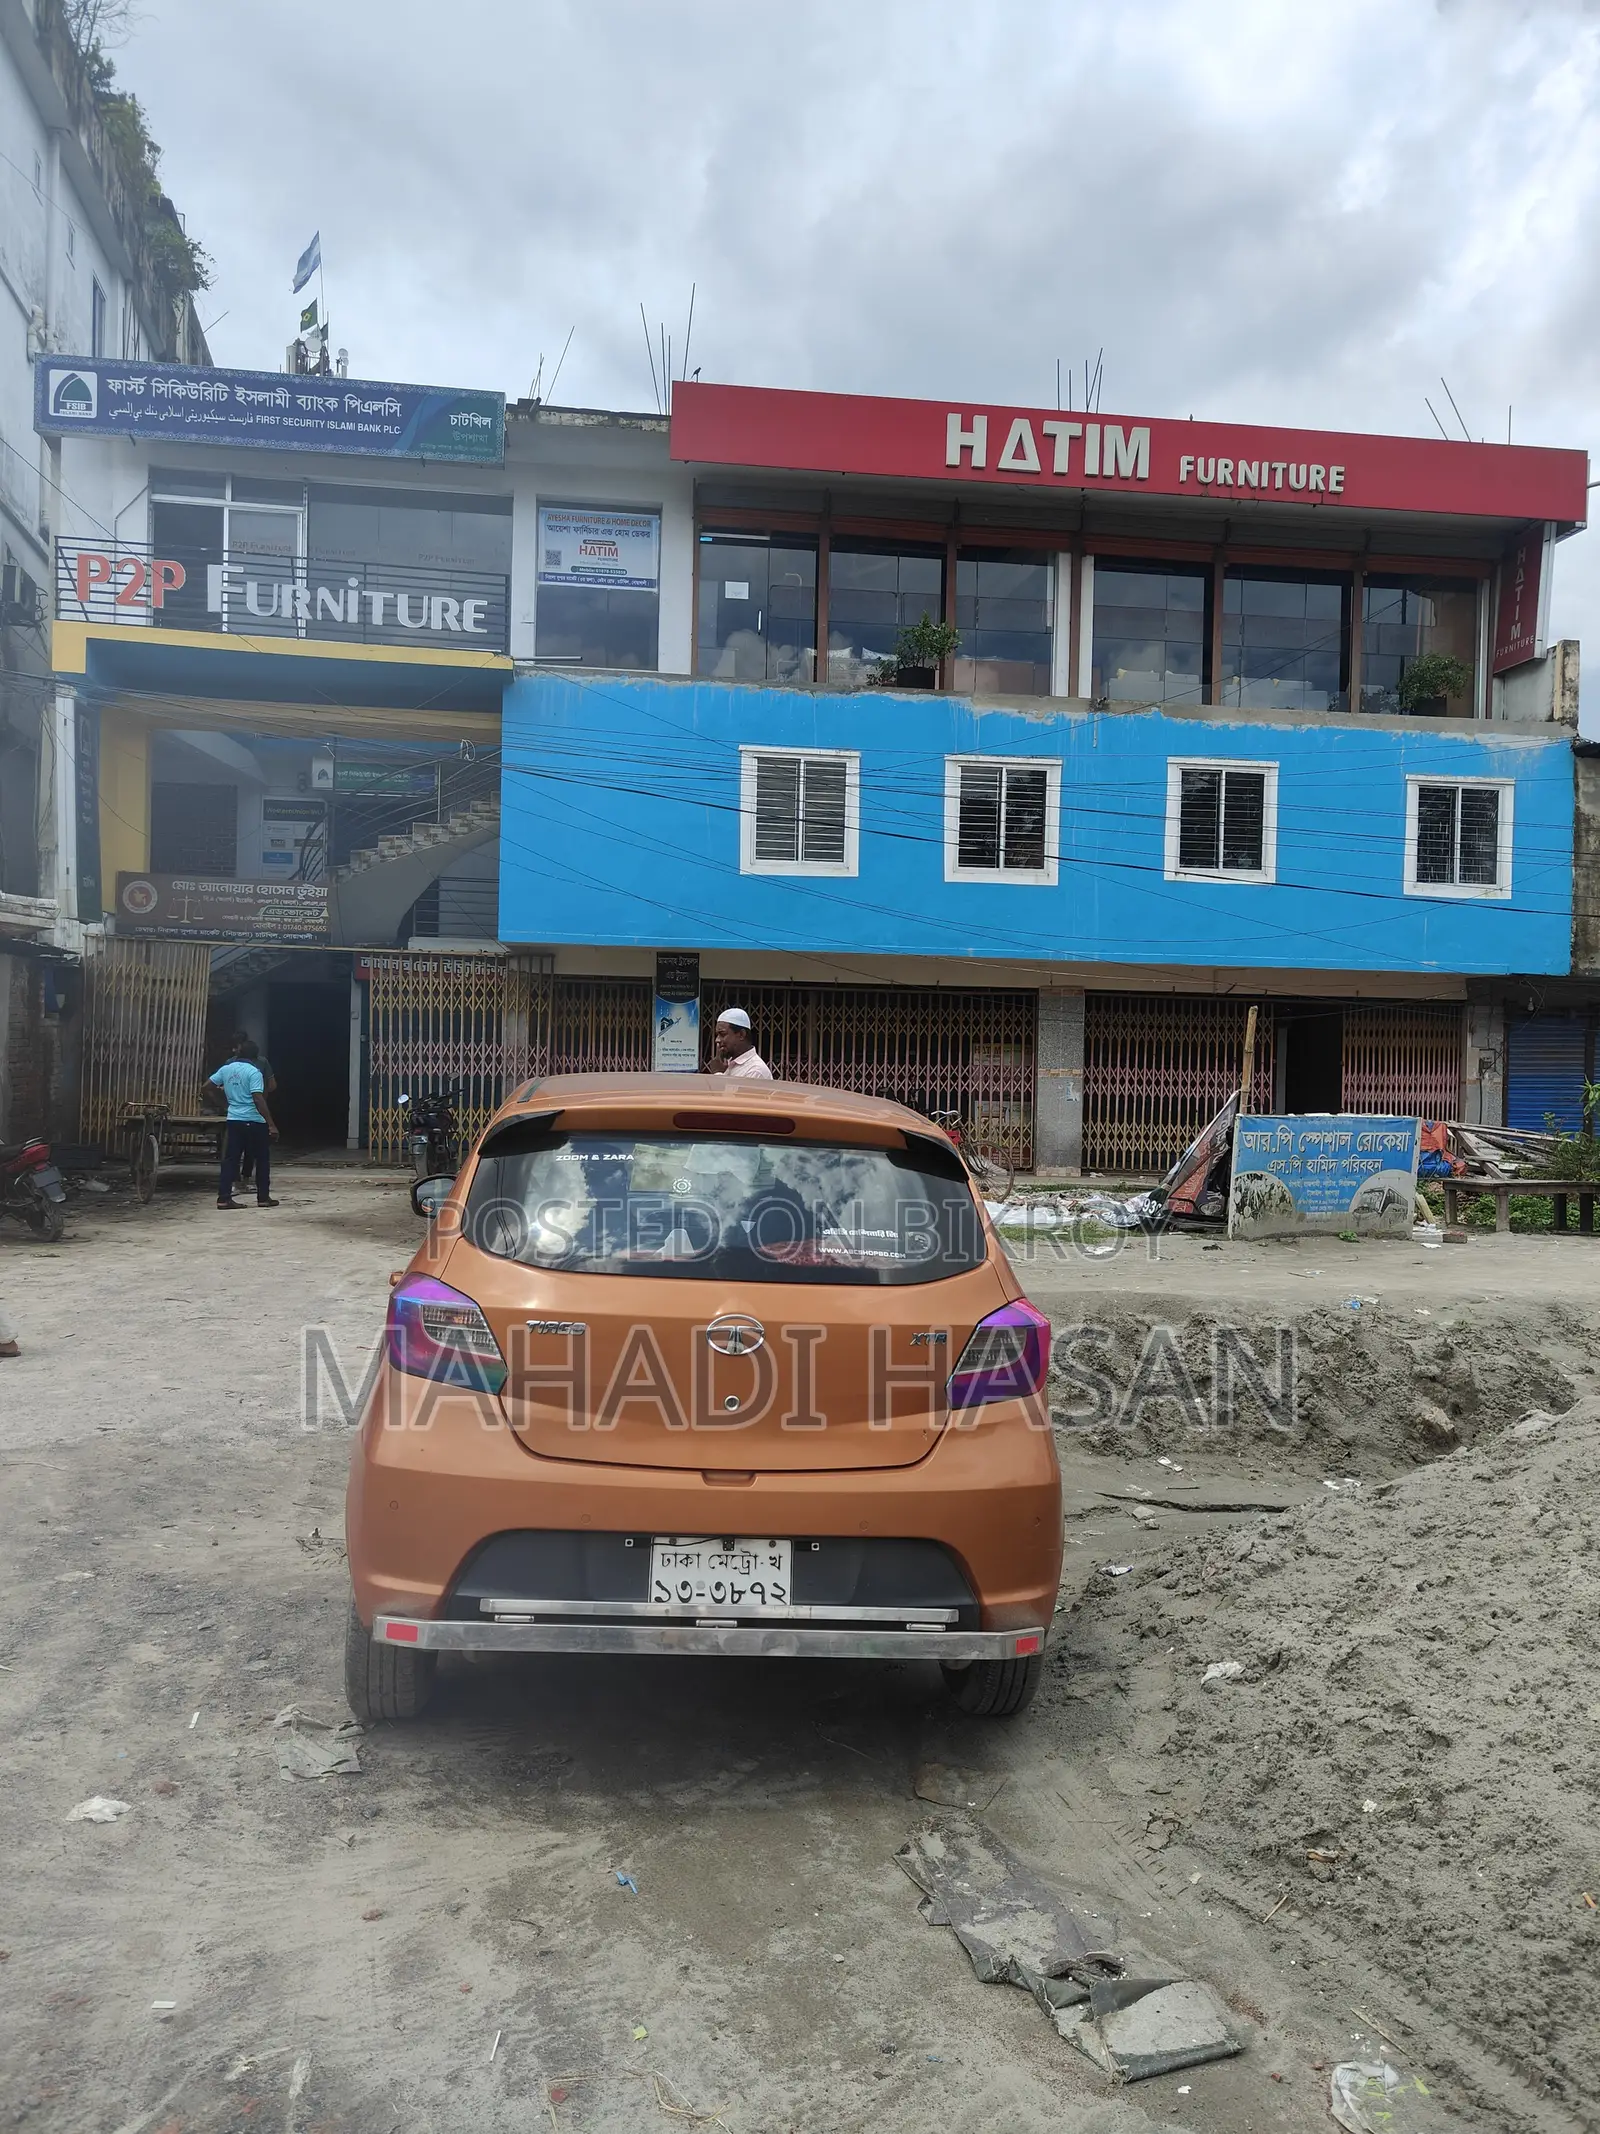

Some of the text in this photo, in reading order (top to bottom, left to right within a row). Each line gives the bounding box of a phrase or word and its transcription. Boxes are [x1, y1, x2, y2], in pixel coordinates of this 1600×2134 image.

[106, 376, 147, 397] ফার্স্ট
[150, 379, 231, 403] সিকিউরিটি
[235, 385, 292, 409] ইসলামী
[296, 393, 339, 414] ব্যাংক
[66, 401, 87, 411] FSIB
[256, 414, 280, 426] FIRST
[282, 416, 325, 429] SECURITY
[327, 420, 356, 431] ISLAMI
[358, 423, 381, 433] BANK
[449, 411, 492, 429] চাটখিল
[945, 411, 1346, 495] HATIM FURNITURE
[572, 515, 606, 526] FURNITURE
[612, 517, 630, 527] HOME
[579, 545, 619, 558] HATIM
[76, 553, 187, 609] P2P
[199, 881, 255, 896] আনোয়ার
[256, 883, 294, 897] হোসেন
[1241, 1124, 1413, 1153] আর.পি স্পেশাল রোকেয়া
[1267, 1153, 1384, 1175] এস.পি হামিদ পরিবহন
[525, 1319, 587, 1335] TIAGO
[660, 1551, 701, 1568] ঢাকা
[654, 1579, 788, 1605] ১৩-৩৮৭২
